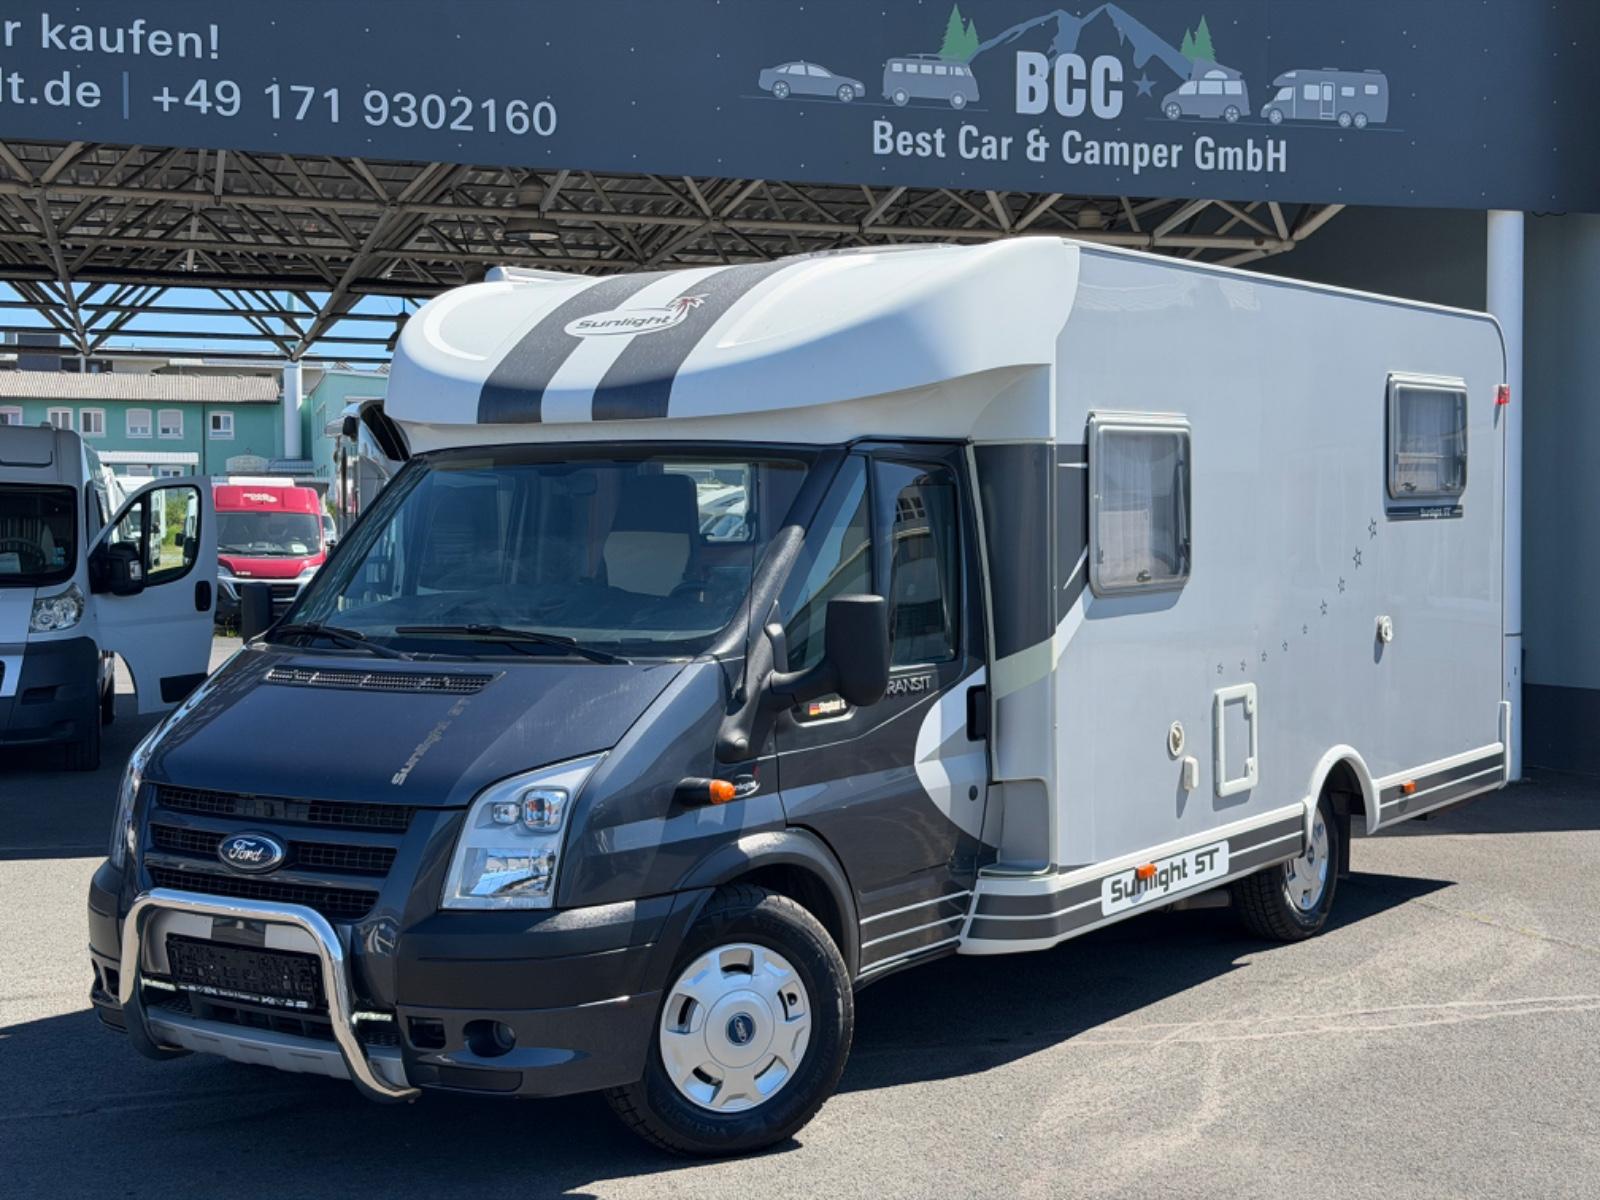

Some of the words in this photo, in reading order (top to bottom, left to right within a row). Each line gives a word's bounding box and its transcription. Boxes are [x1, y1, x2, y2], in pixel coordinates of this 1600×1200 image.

[41, 12, 220, 60] kaufen!
[1015, 50, 1124, 120] BCC
[152, 79, 241, 118] +49
[264, 84, 340, 123] 171
[363, 90, 558, 137] 9302160
[873, 119, 947, 158] Best
[958, 124, 1013, 162] Car
[1026, 127, 1051, 163] &
[1061, 130, 1183, 175] Camper
[1194, 136, 1288, 173] GmbH
[576, 315, 671, 328] Sunlight
[886, 675, 932, 695] RANSIT
[228, 839, 263, 861] Ford
[1195, 847, 1220, 874] ST
